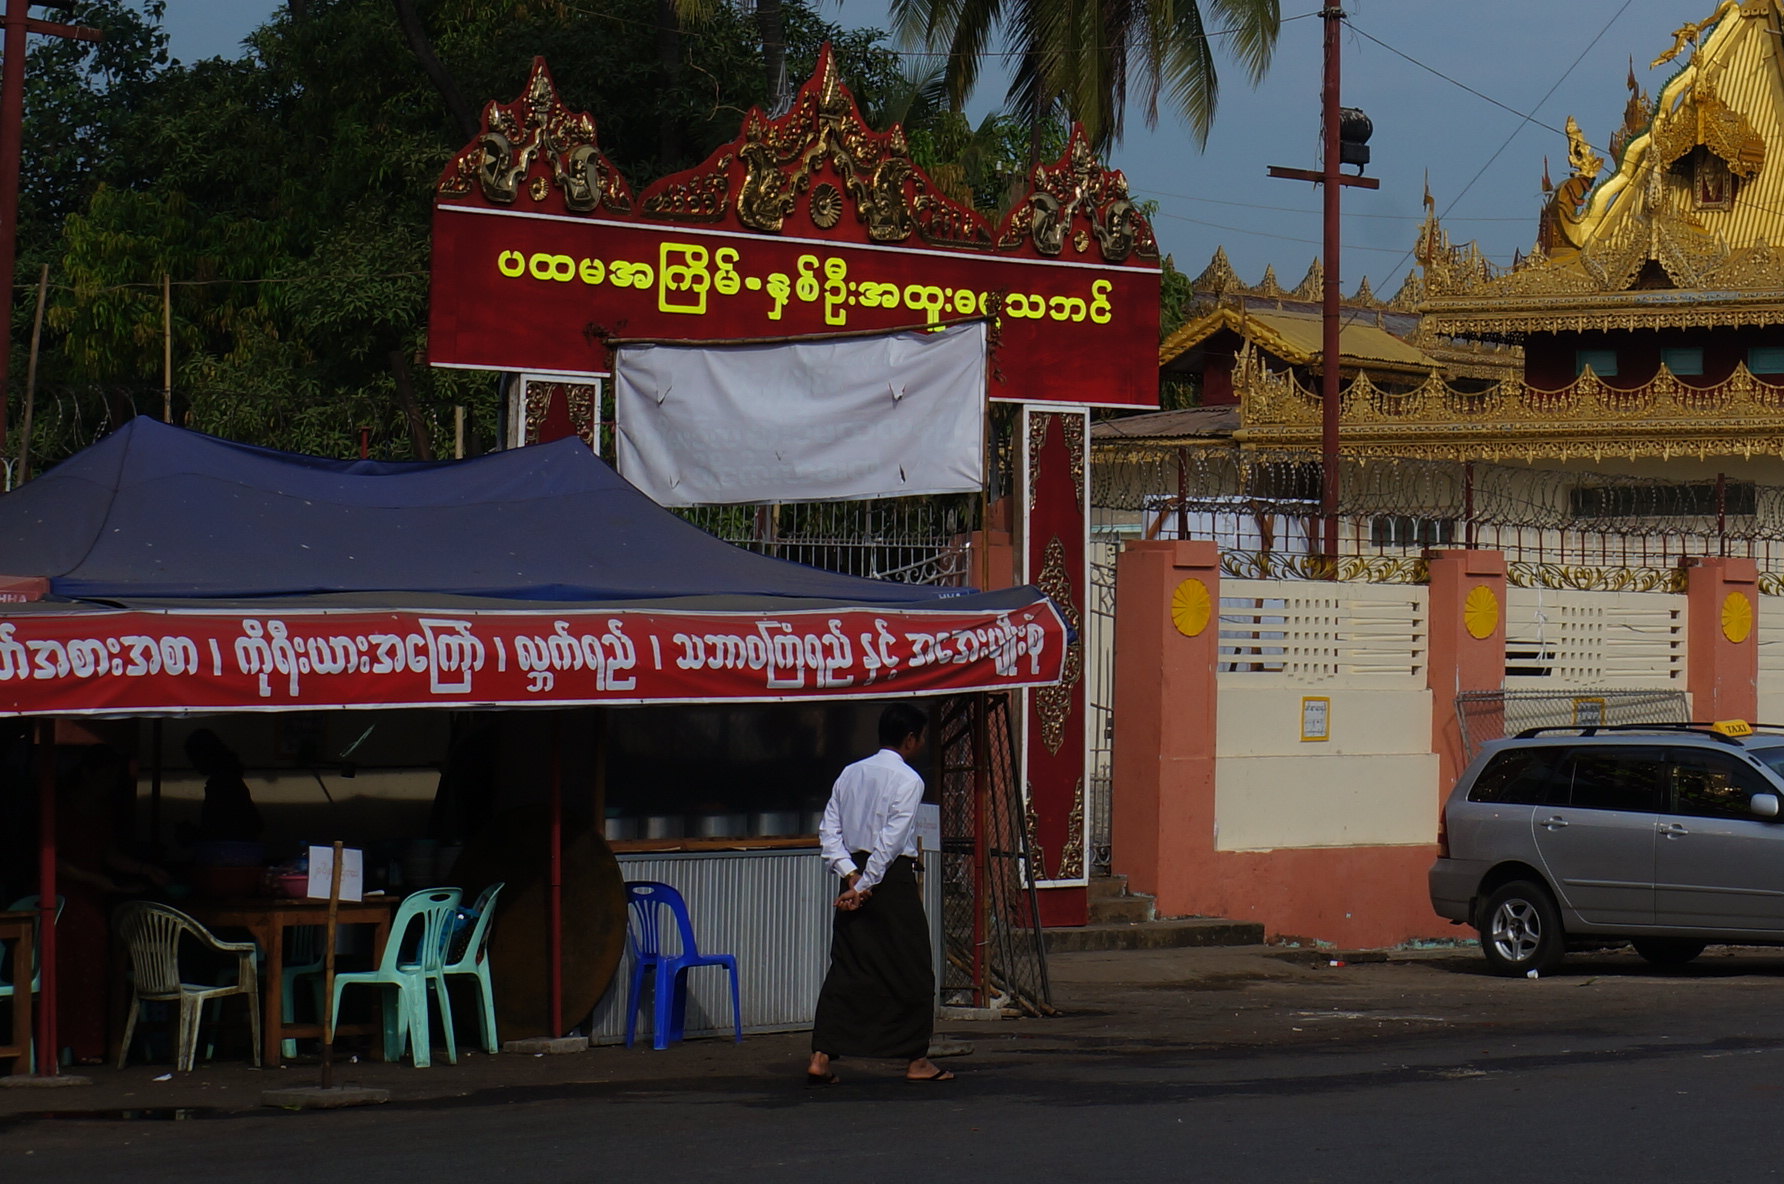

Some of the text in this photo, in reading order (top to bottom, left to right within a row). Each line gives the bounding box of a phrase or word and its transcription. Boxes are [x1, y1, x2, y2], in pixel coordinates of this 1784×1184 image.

[497, 241, 1113, 332] ပထမအကြိမ်-နှစ်ဦးအထူးဓသဘင်
[1725, 724, 1747, 734] TAXI
